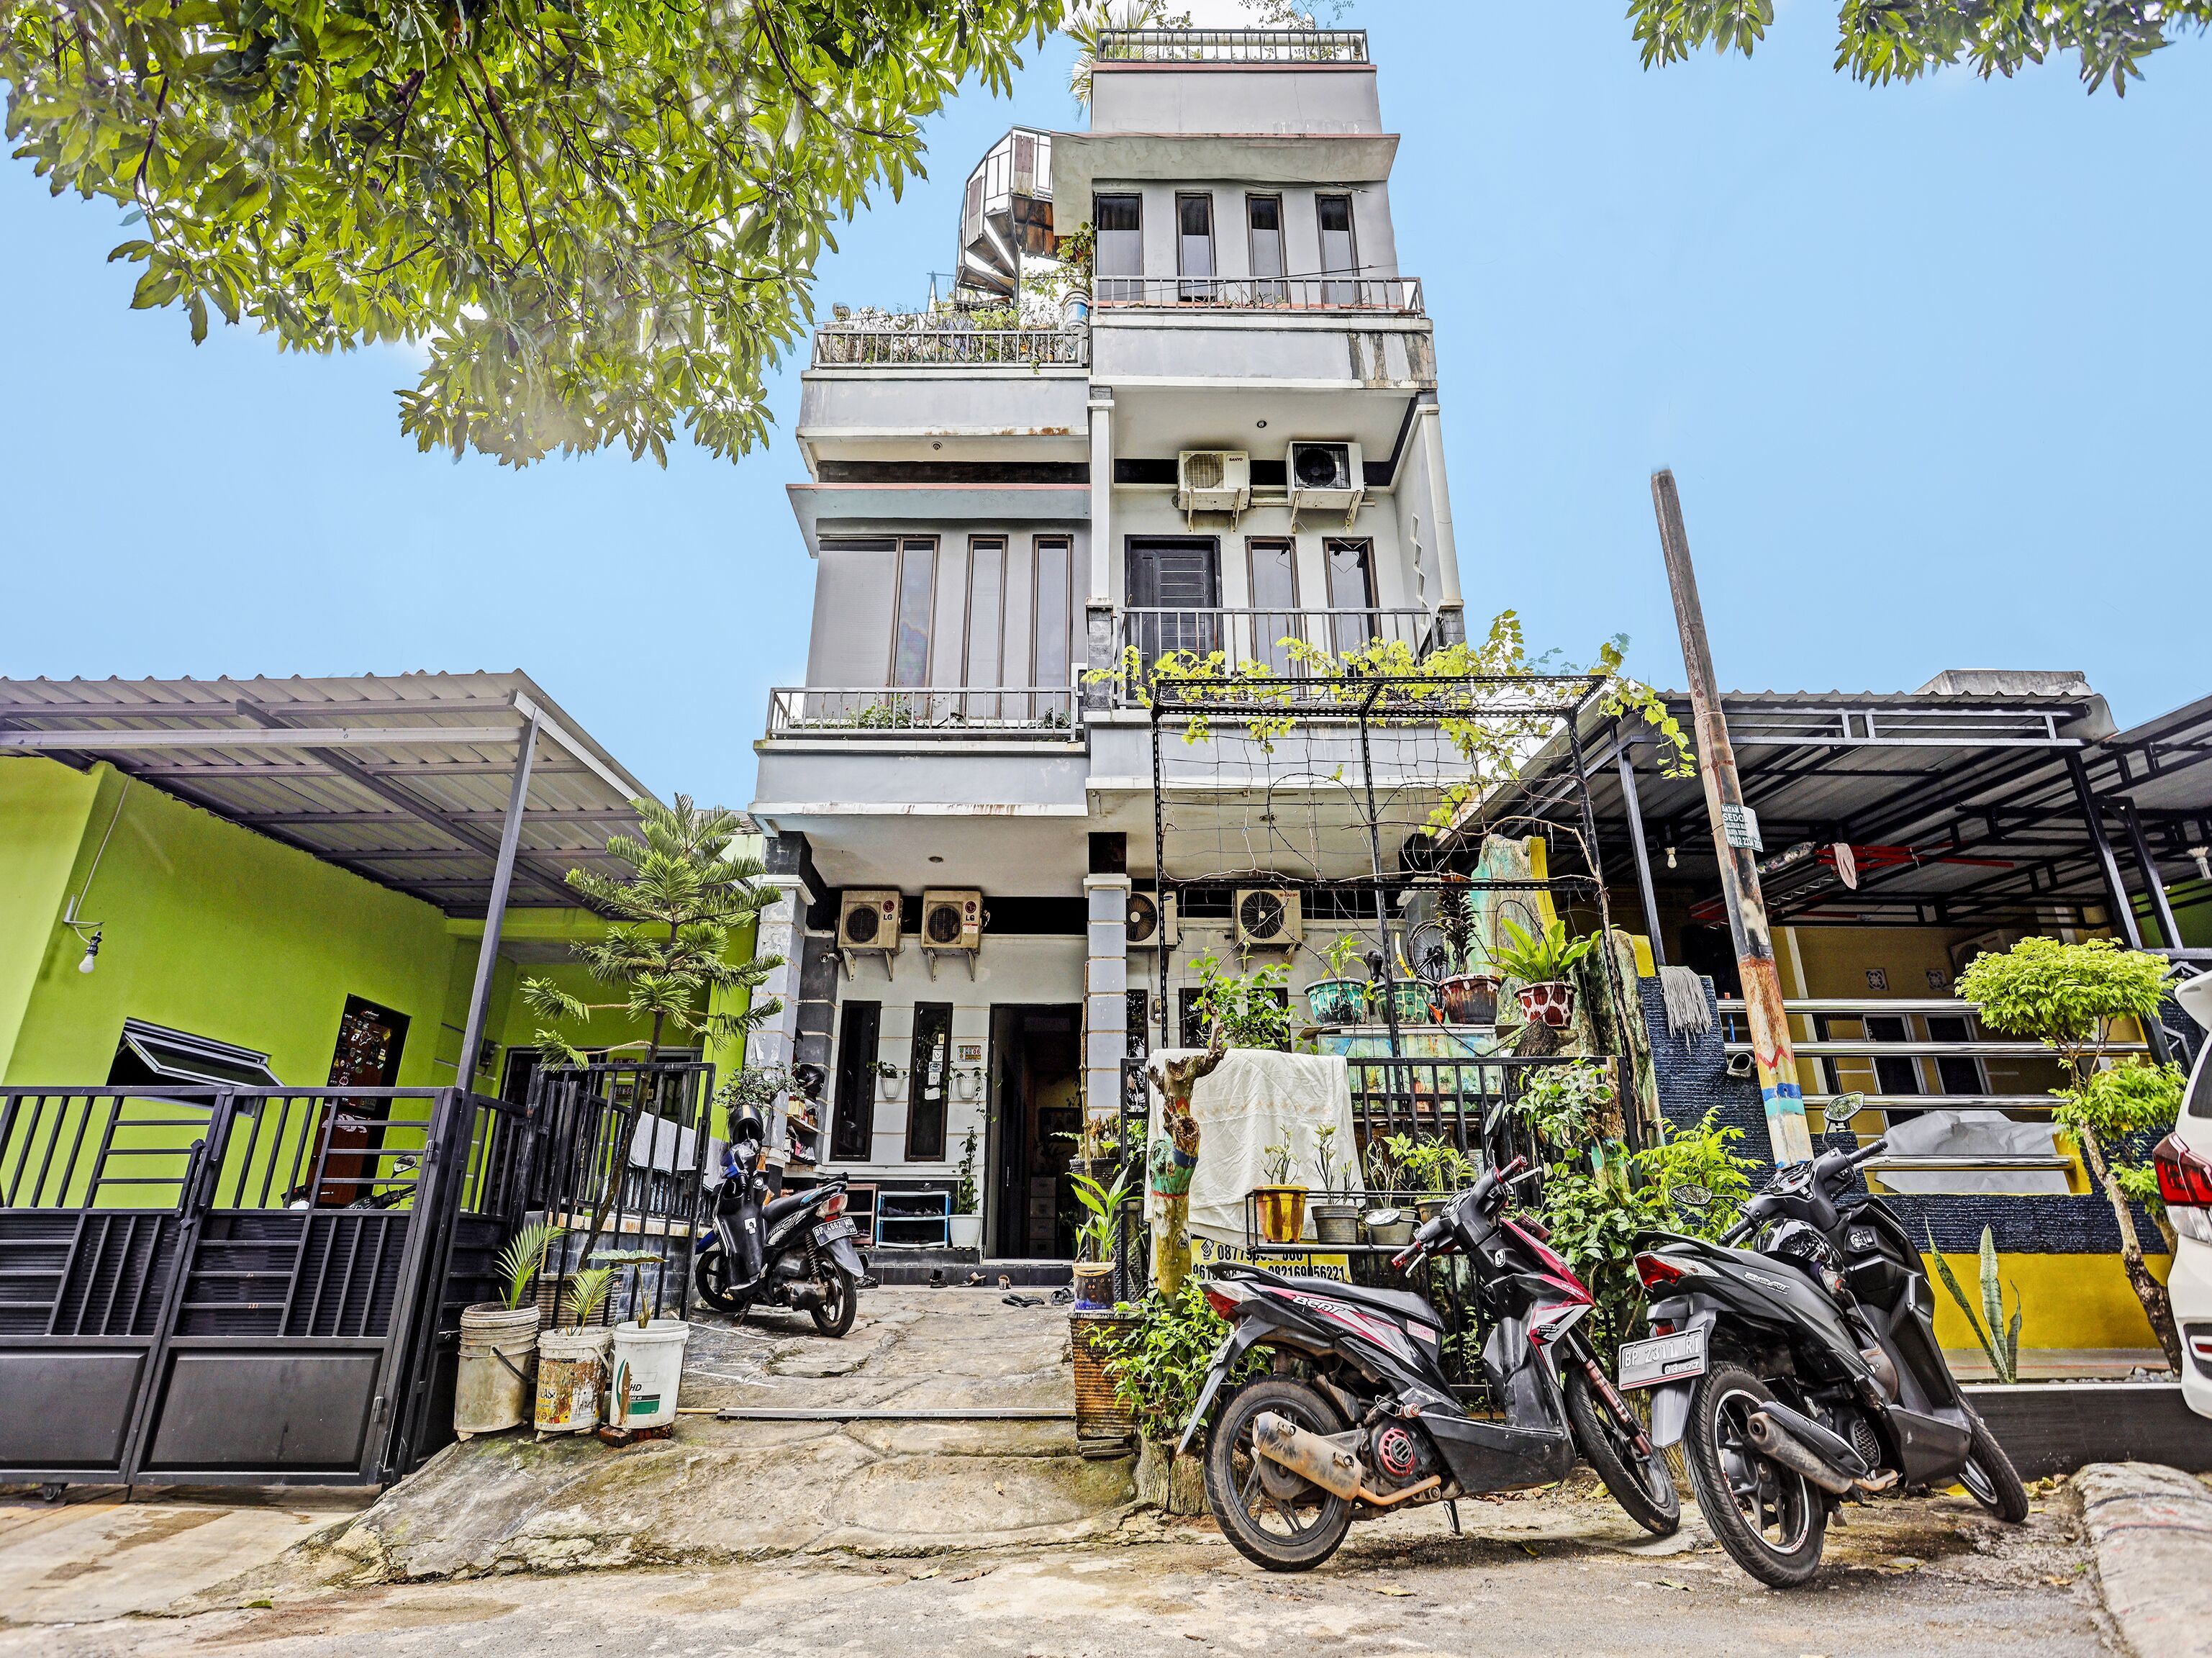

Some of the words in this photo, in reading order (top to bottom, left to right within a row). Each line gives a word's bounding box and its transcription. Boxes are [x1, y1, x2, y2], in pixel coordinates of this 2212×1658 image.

[814, 1226, 824, 1237] BP
[827, 1221, 843, 1231] 4662
[1560, 1282, 1586, 1299] HONDA
[1624, 1349, 1638, 1368] BP
[1644, 1341, 1675, 1364] 2311
